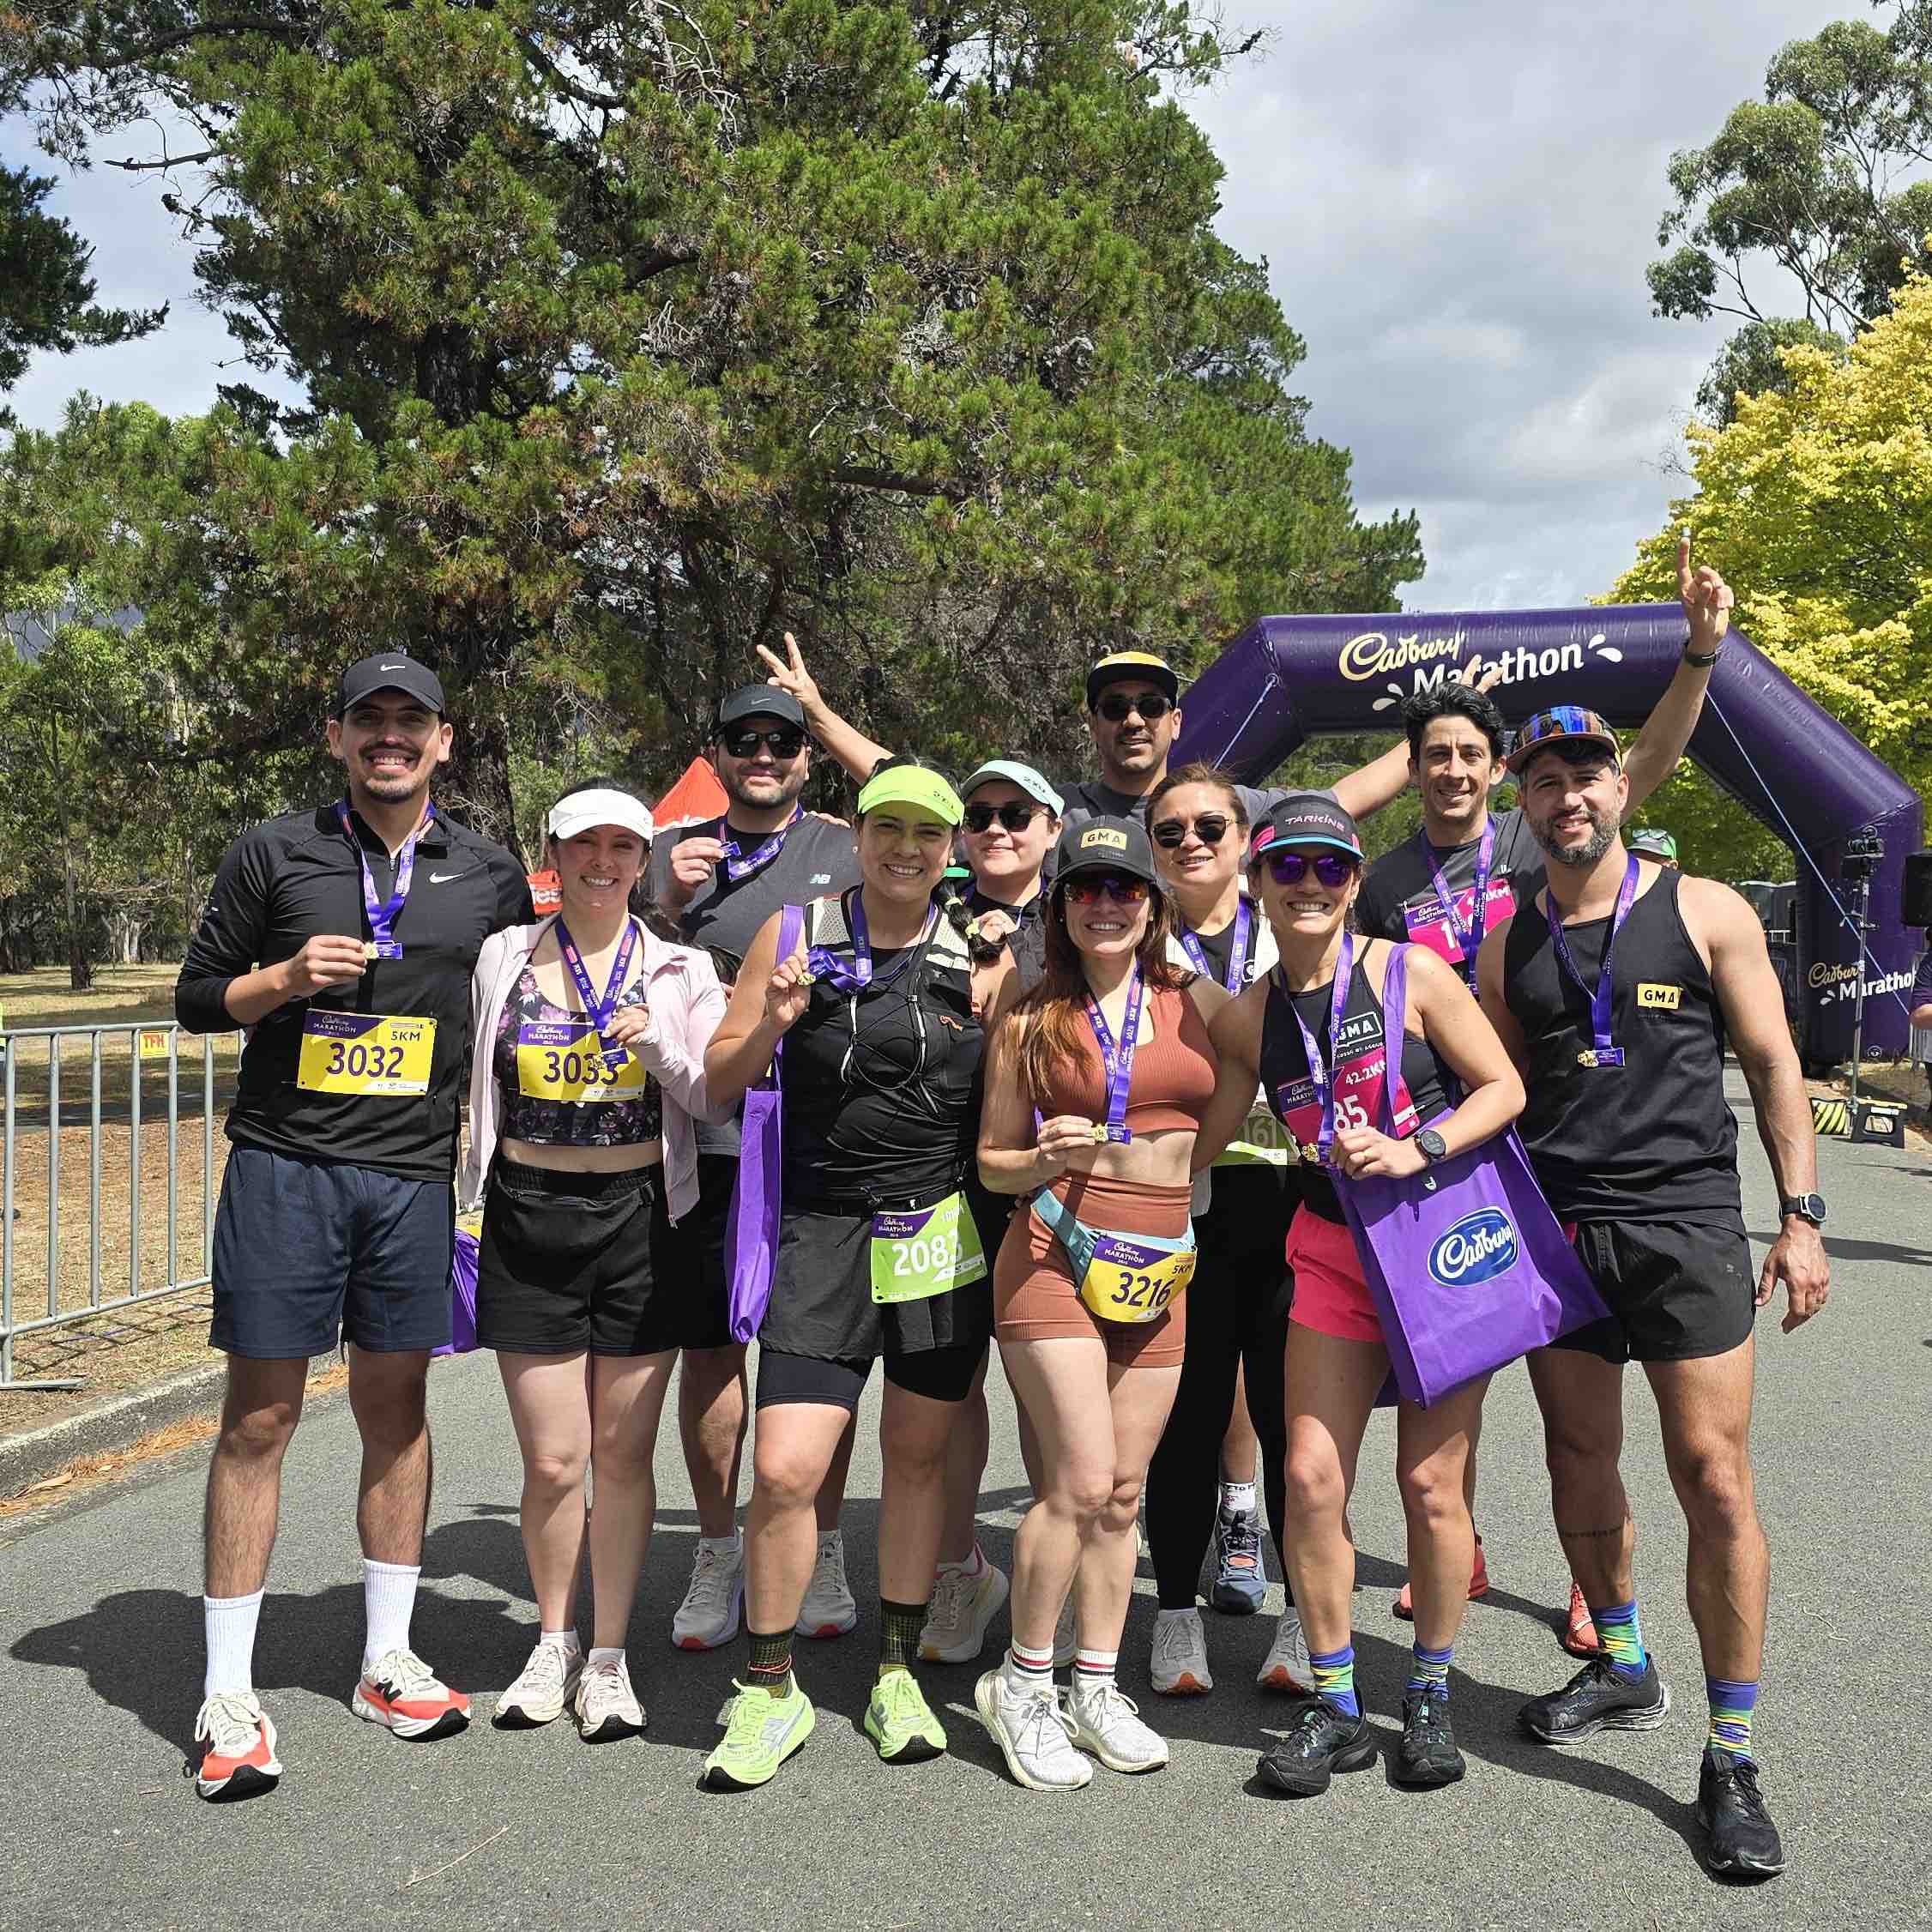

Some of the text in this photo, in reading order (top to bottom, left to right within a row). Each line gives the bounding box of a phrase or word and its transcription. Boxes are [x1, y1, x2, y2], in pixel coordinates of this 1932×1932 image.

[1339, 631, 1465, 681] Cadbury
[1413, 643, 1584, 695] Maathon
[1087, 832, 1120, 845] GMA
[1808, 962, 1860, 988] Cadbur
[1644, 989, 1675, 1004] GMA
[313, 1023, 357, 1033] MARATHON
[390, 1031, 421, 1041] 5KM
[325, 1042, 405, 1078] 3032
[1104, 1248, 1145, 1264] MARATHON
[1437, 1224, 1513, 1279] Cadbury
[1111, 1271, 1175, 1308] 3216
